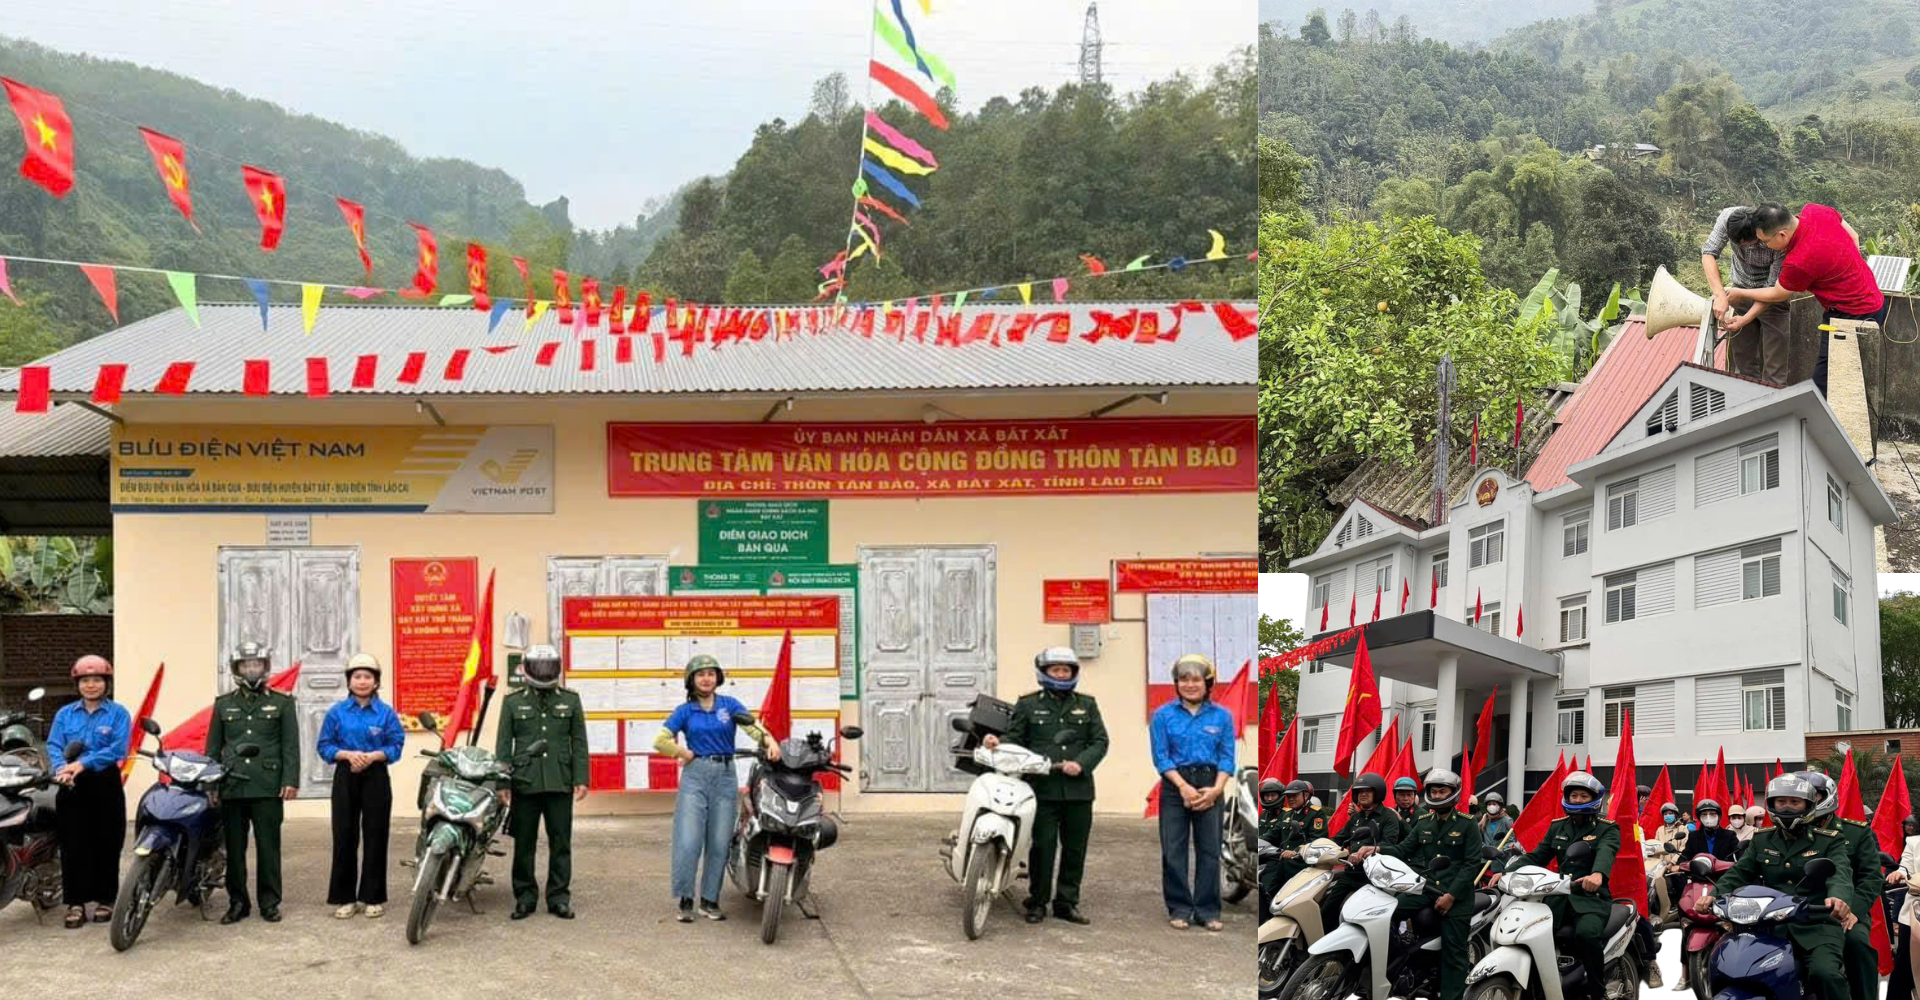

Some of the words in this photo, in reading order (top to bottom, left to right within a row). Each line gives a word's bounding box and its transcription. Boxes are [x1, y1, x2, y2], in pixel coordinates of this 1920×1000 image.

[822, 432, 858, 444] BAN
[864, 428, 915, 443] NHÂN
[921, 428, 958, 442] DÂN
[964, 427, 990, 442] XÃ
[119, 438, 172, 456] BƯU
[179, 438, 242, 461] ĐIỆN
[247, 437, 302, 461] VIỆT
[309, 442, 364, 457] NAM
[630, 450, 713, 472] TRUNG
[720, 447, 773, 472] TÂM
[782, 448, 832, 472] VĂN
[840, 447, 890, 471] HÓA
[899, 446, 968, 475] CỘNG
[975, 442, 1046, 471] ĐỒNG
[1054, 443, 1121, 470] THÔN
[1128, 442, 1178, 468] TÂN
[1185, 440, 1237, 467] BẢO
[782, 478, 831, 490] THÔN
[837, 478, 872, 490] TÂN
[1132, 475, 1163, 487] CAI
[472, 487, 516, 496] VIETNAM
[520, 487, 547, 496] POST
[719, 528, 745, 541] ĐIỂM
[748, 528, 778, 541] GIAO
[780, 528, 809, 541] DỊCH
[763, 541, 789, 553] QUA
